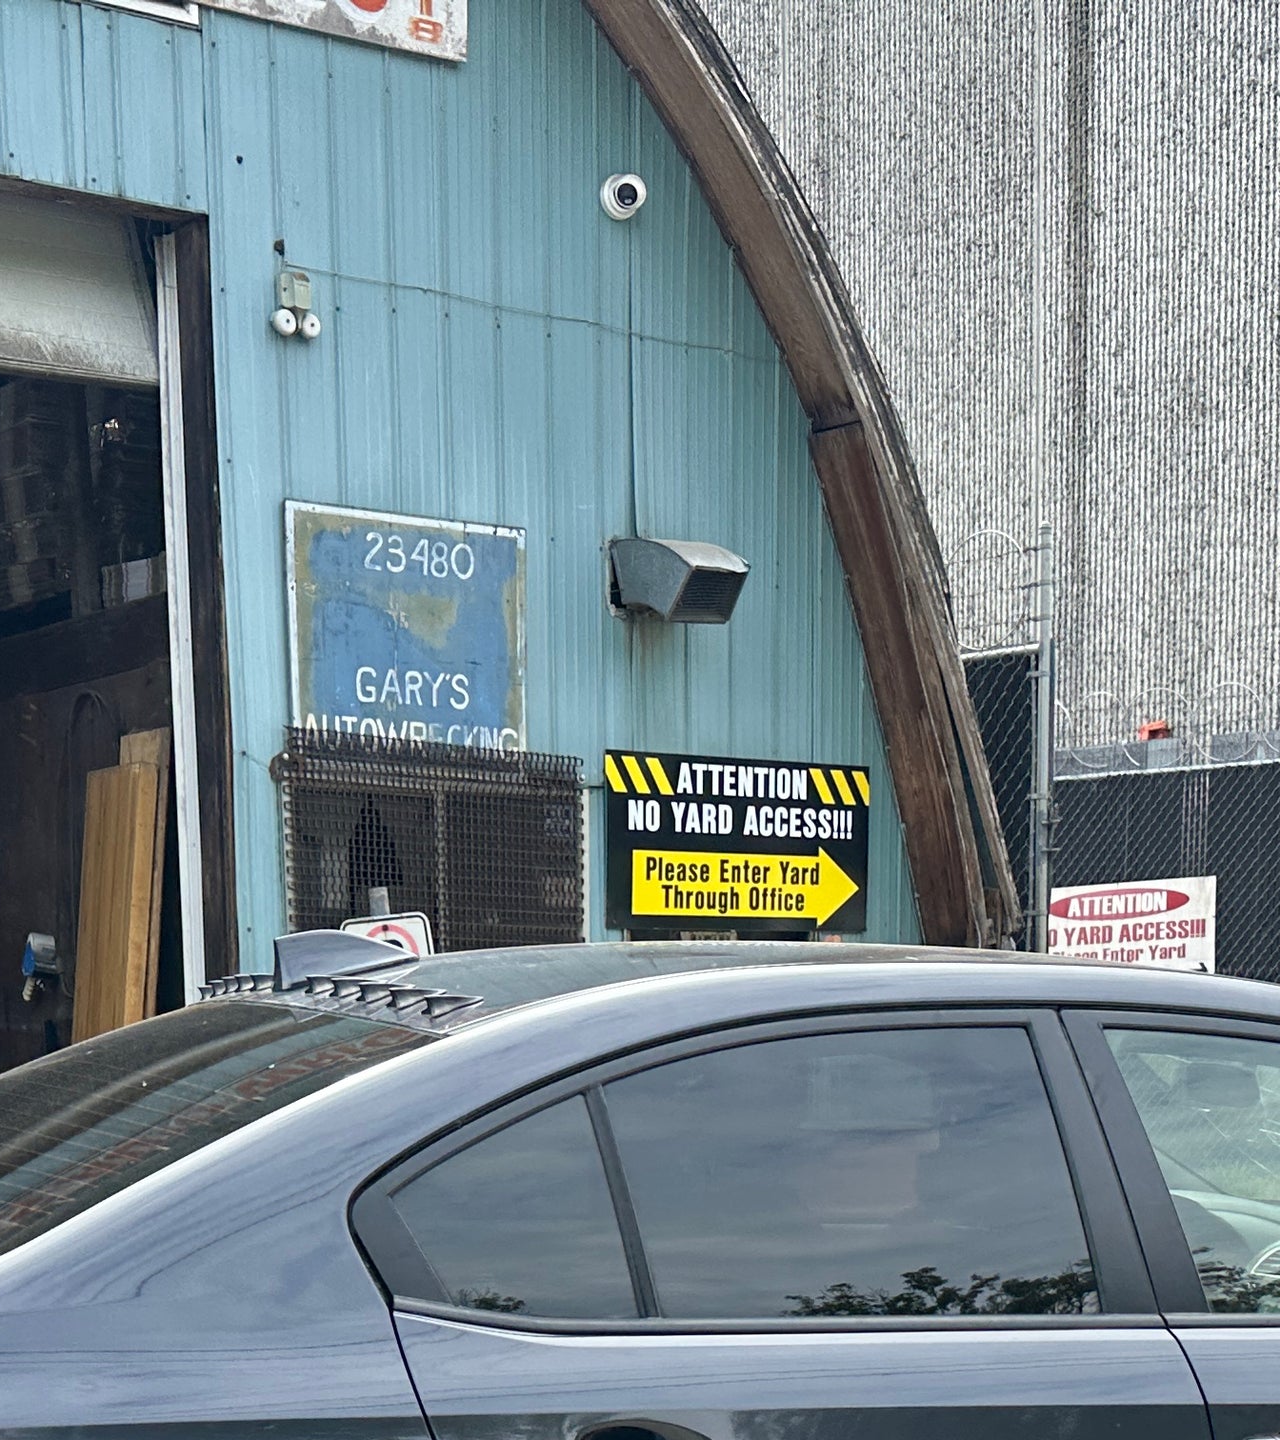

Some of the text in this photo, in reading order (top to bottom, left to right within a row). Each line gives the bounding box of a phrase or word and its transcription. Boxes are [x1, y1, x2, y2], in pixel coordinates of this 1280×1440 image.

[364, 532, 475, 580] 23480
[355, 666, 470, 710] GARY'S
[676, 762, 808, 800] ATTENTION
[628, 799, 853, 840] NO YARD ACCESS!!!
[646, 856, 820, 886] Please Enter Yard
[662, 885, 805, 914] Through Office
[1067, 891, 1168, 917] ATTENTION
[1064, 925, 1113, 946] YARD
[1118, 919, 1206, 944] ACCESS!!!
[1148, 943, 1186, 961] Yard
